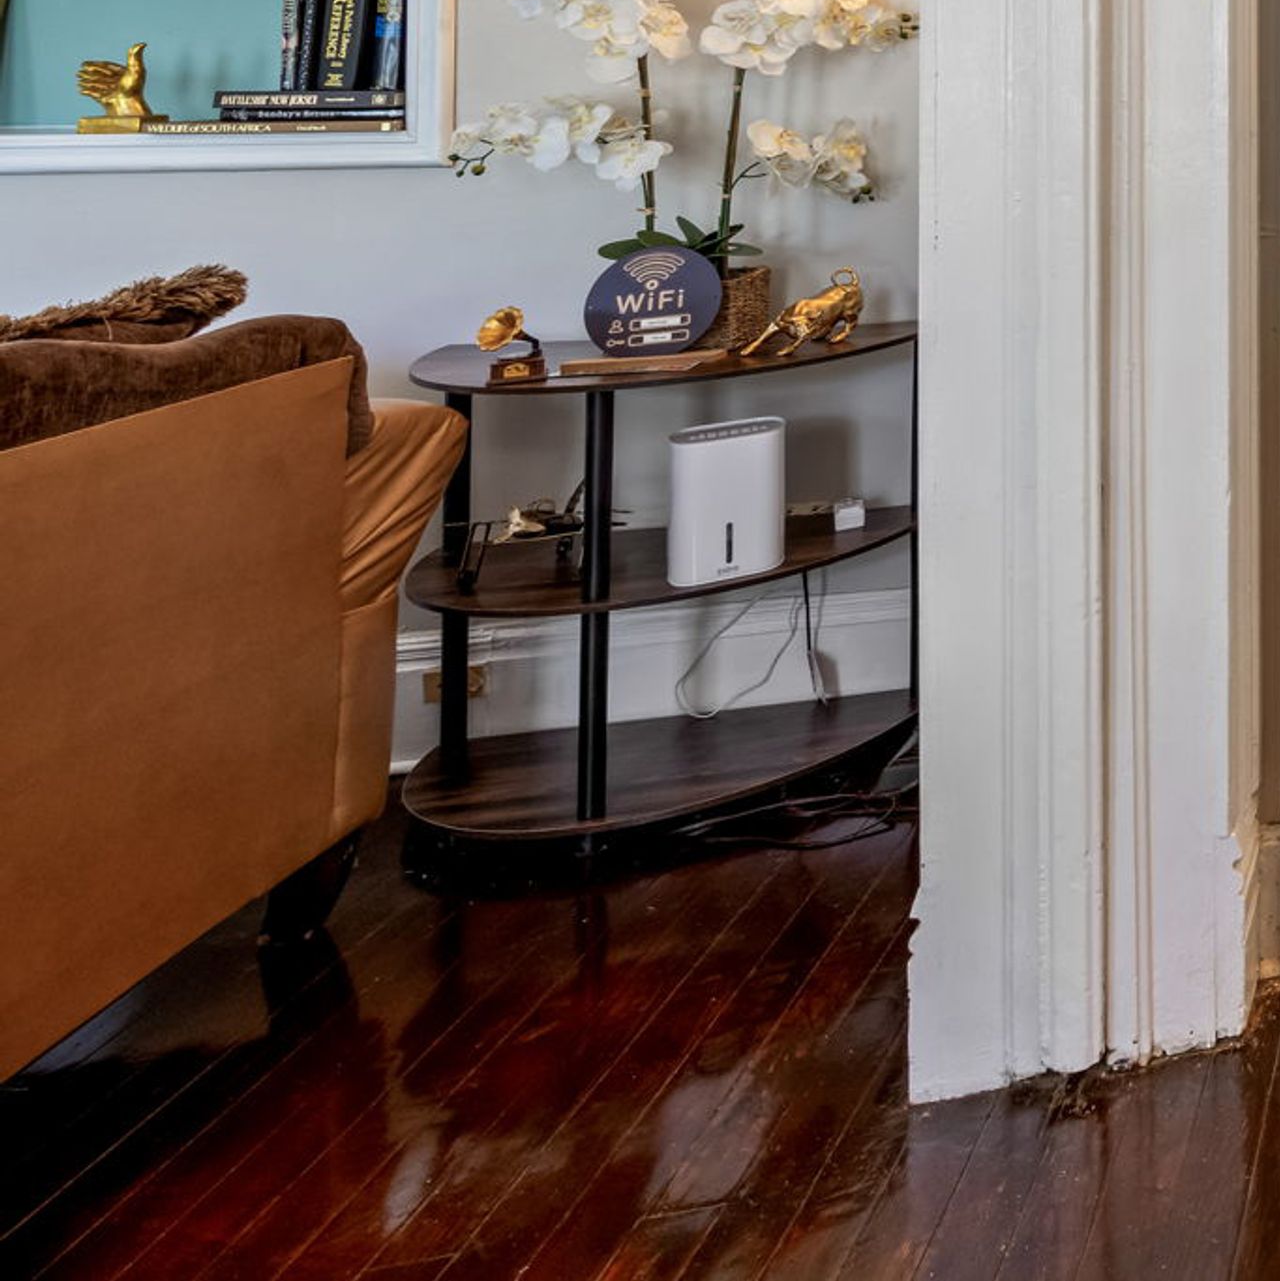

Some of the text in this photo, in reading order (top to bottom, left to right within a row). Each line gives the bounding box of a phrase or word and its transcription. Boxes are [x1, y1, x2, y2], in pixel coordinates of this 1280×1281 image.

[220, 95, 268, 105] BATTLESHIP
[200, 124, 236, 132] SOUTH
[236, 123, 271, 132] AFRICA
[616, 289, 685, 315] WiFi
